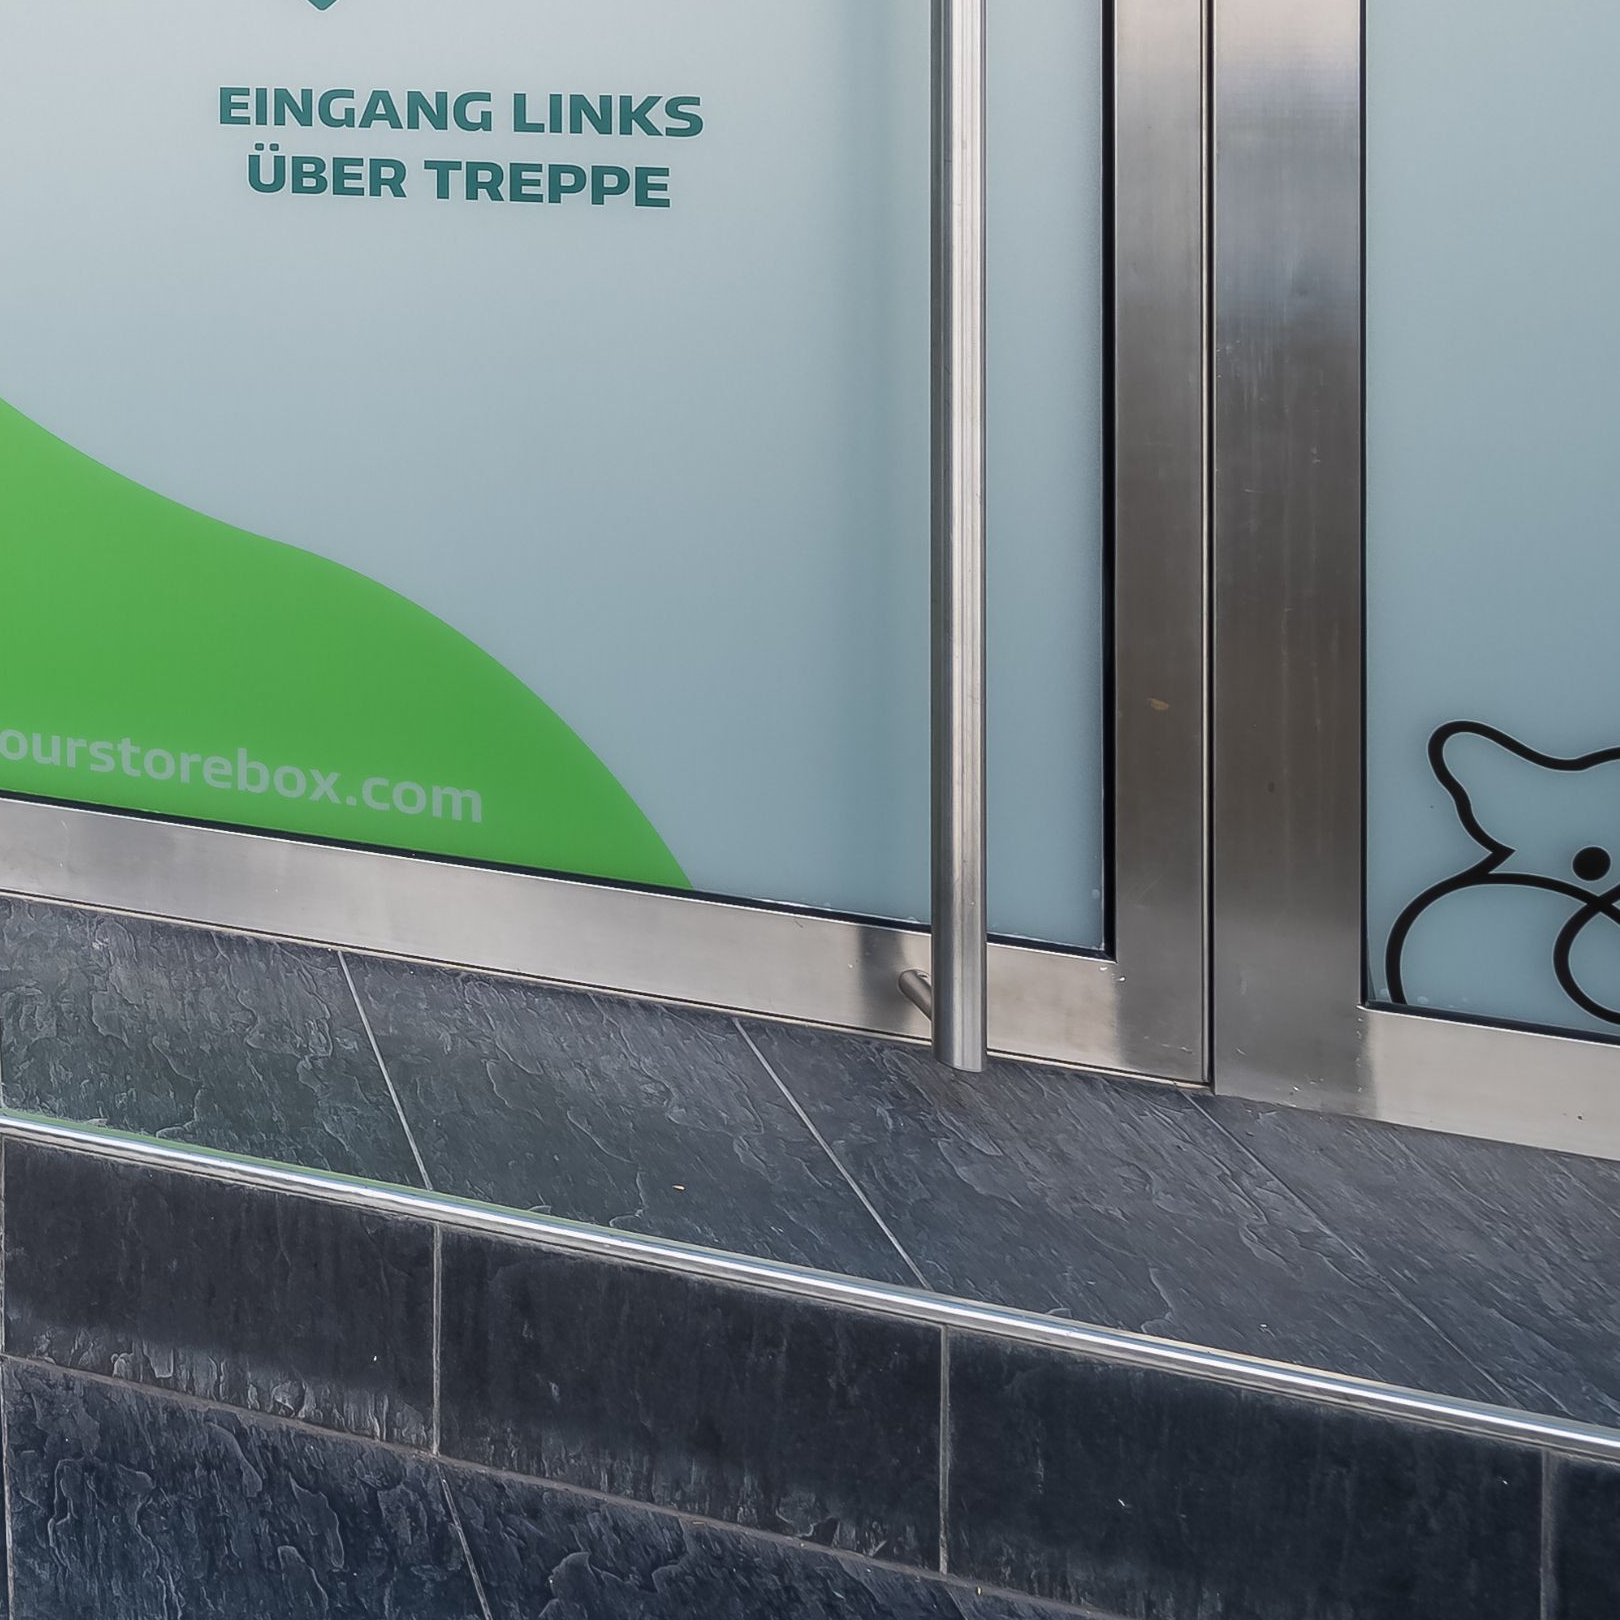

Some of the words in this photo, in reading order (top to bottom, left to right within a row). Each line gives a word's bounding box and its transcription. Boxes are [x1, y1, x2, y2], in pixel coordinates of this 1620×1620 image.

[219, 86, 493, 132] EINGANG
[513, 92, 704, 137] LINKS
[247, 142, 407, 198] ÜBER
[424, 159, 671, 208] TREPPE
